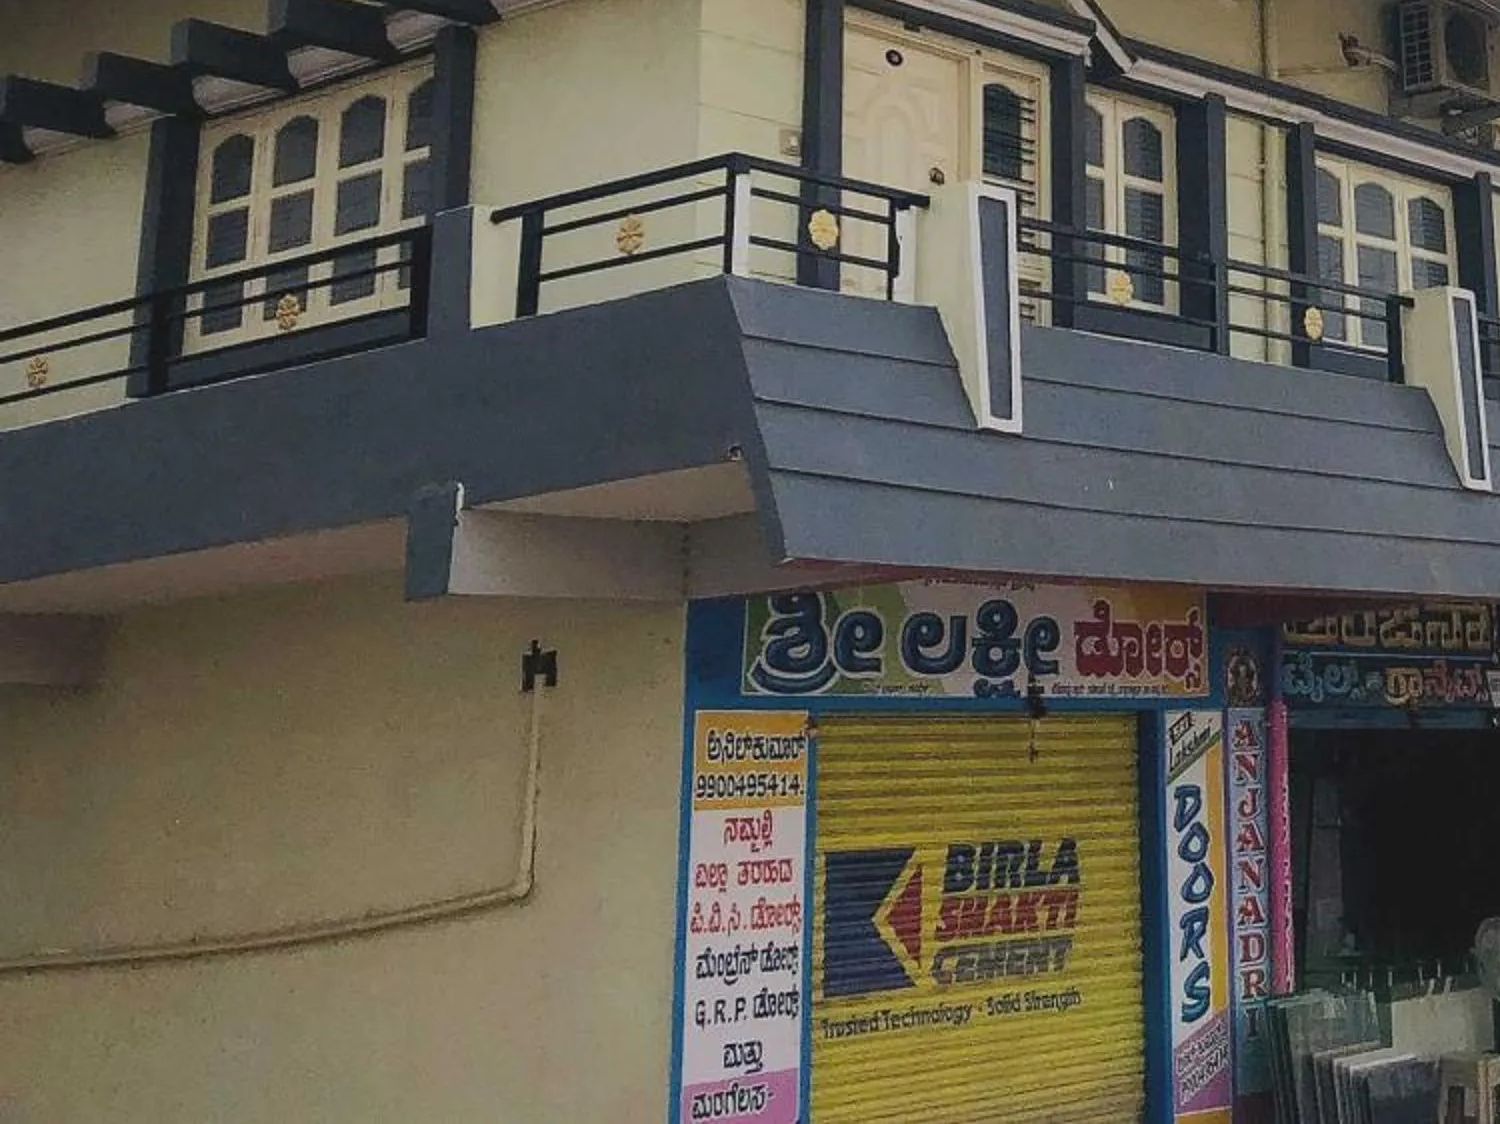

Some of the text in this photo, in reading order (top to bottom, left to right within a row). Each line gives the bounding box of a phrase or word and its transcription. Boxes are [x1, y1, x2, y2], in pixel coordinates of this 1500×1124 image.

[750, 589, 884, 695] ಶ್ರೀ
[1073, 598, 1204, 690] ಡೋರ್ಸ್
[737, 858, 793, 886] ತರಹದ
[943, 837, 1081, 893] BIRLA
[1233, 719, 1268, 1038] ANJANADRI
[935, 888, 1079, 941] SHAKTI
[1174, 784, 1214, 1023] DOORS
[931, 935, 1073, 984] CEMENT
[879, 1000, 972, 1026] Technology
[723, 1039, 763, 1074] ಮತ್ತು
